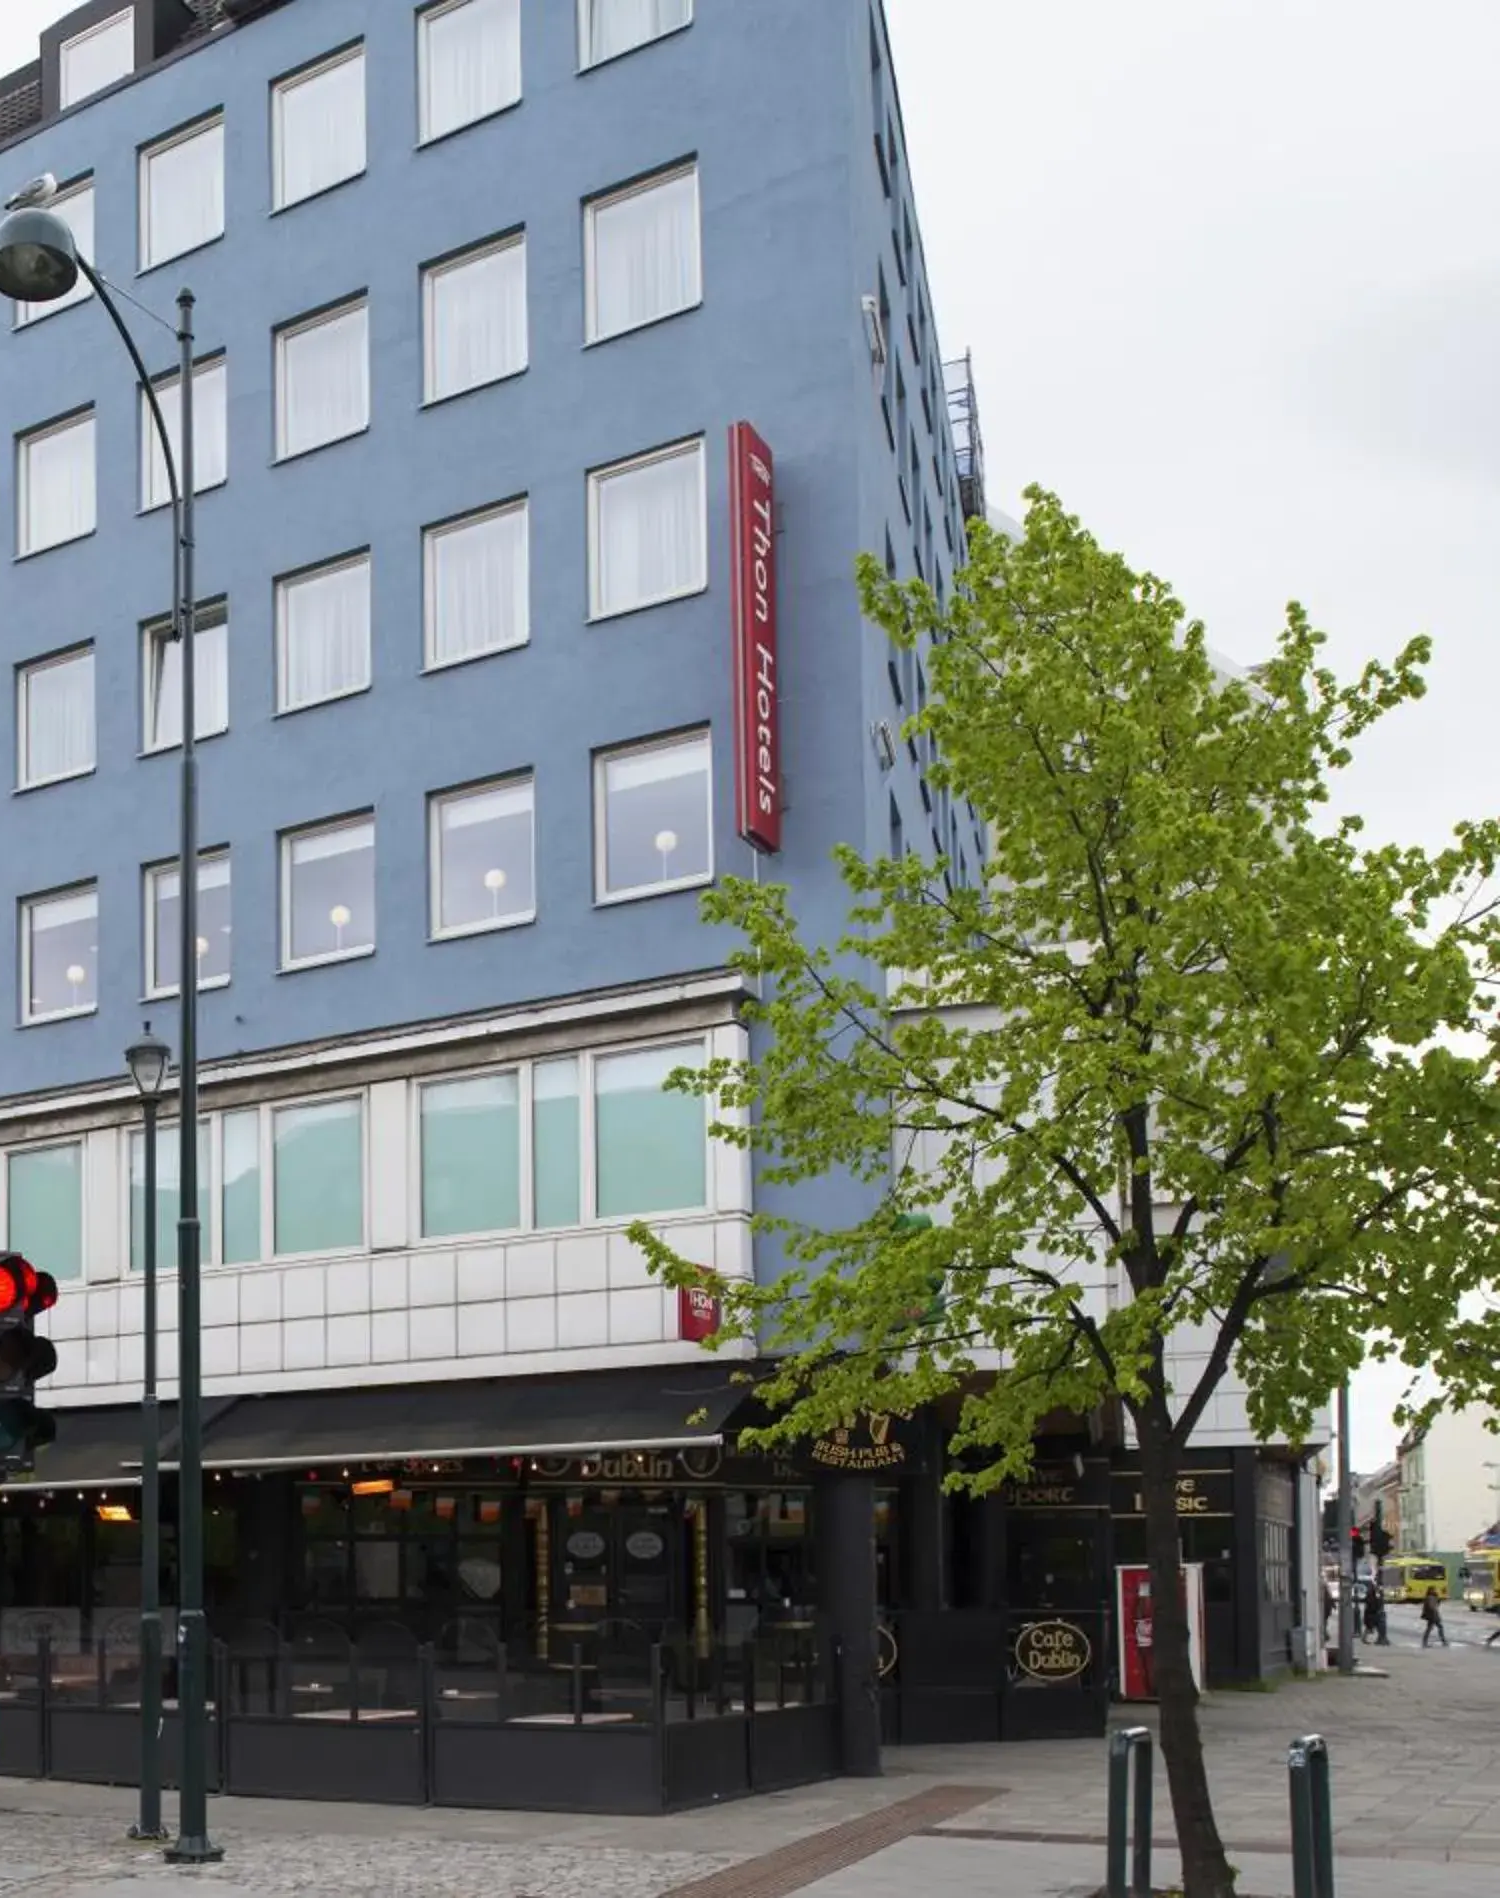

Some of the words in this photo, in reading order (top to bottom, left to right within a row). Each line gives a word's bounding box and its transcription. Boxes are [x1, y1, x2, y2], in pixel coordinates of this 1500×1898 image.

[753, 499, 771, 623] Thon
[756, 642, 775, 815] Hotels
[813, 1439, 856, 1458] IRISH
[1031, 1630, 1074, 1650] Cafe
[1029, 1650, 1081, 1670] Dublin
